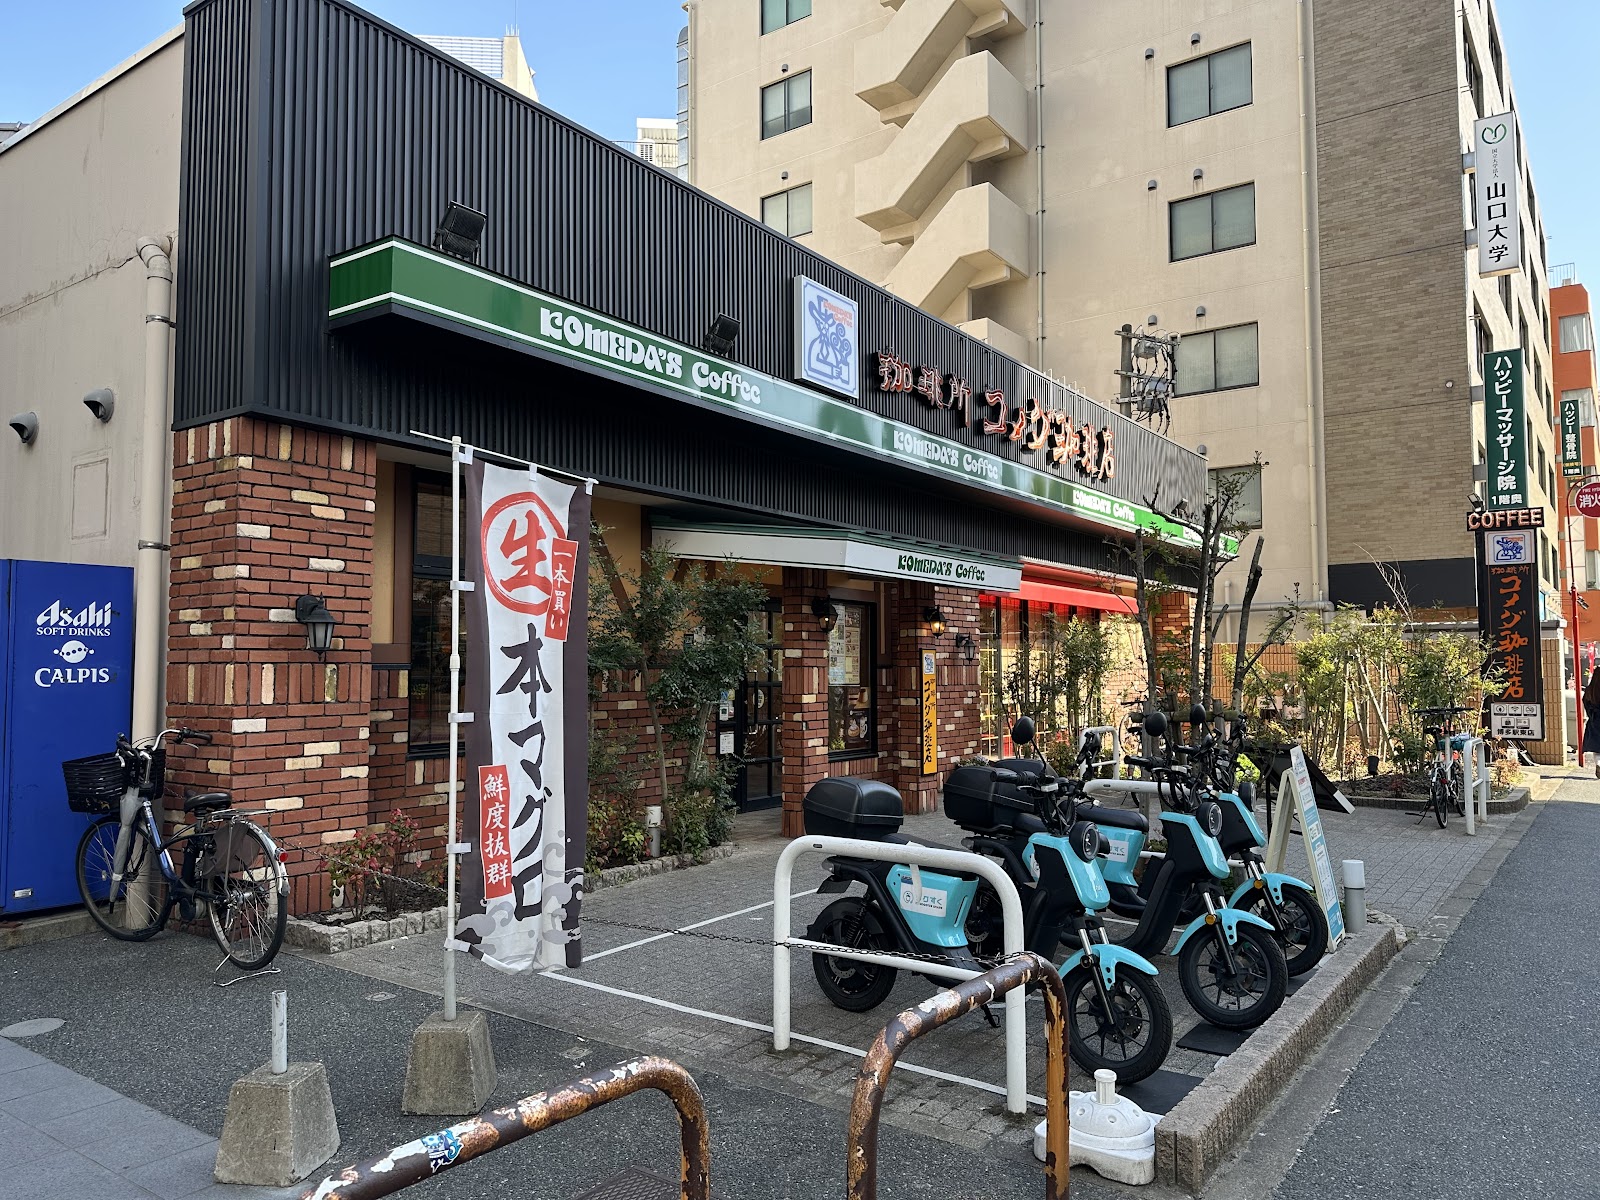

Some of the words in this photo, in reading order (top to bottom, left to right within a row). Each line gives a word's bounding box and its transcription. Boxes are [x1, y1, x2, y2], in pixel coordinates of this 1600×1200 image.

[1486, 182, 1509, 263] 山口大学
[540, 307, 683, 379] KOMEDA'S
[691, 361, 761, 405] Coffee
[893, 430, 959, 467] KOMEDA'S
[963, 453, 999, 480] Coffee
[1494, 355, 1517, 491] ハッピーマッサージ院
[1468, 508, 1543, 530] COFFEE
[1491, 493, 1523, 506] 1階奥
[500, 509, 553, 597] 生
[550, 551, 573, 630] 一本買い
[897, 554, 952, 577] KOMEDA'S
[955, 563, 985, 582] Coffee
[36, 600, 112, 627] Asahi
[36, 627, 67, 636] SOFT
[68, 627, 111, 637] DRINKS
[1498, 575, 1529, 700] コメダ珈琲店
[34, 667, 110, 688] CALPIS
[496, 622, 553, 922] 本マグロ
[483, 773, 511, 888] 鮮度抜群
